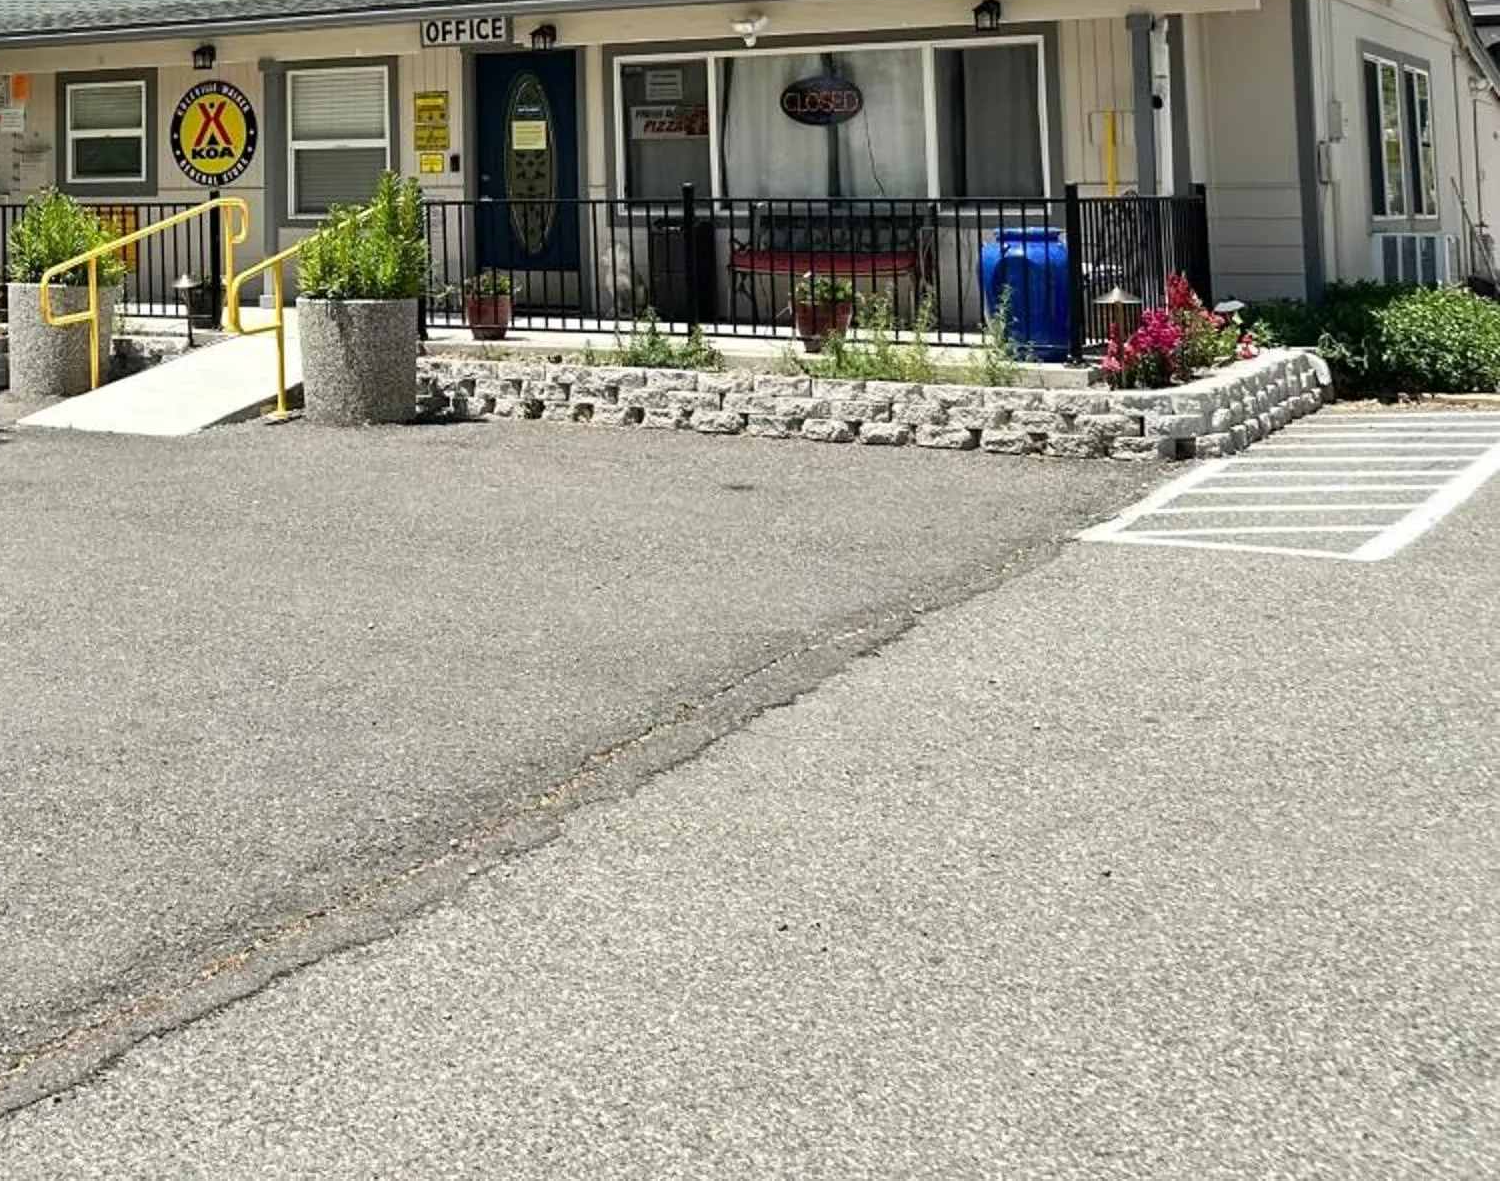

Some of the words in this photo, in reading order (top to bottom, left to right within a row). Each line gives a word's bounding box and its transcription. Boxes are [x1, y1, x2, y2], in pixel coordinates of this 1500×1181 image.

[426, 18, 502, 42] OFFICE
[783, 90, 859, 112] CLOSED
[643, 120, 683, 132] PIZZA
[191, 146, 235, 160] KOA
